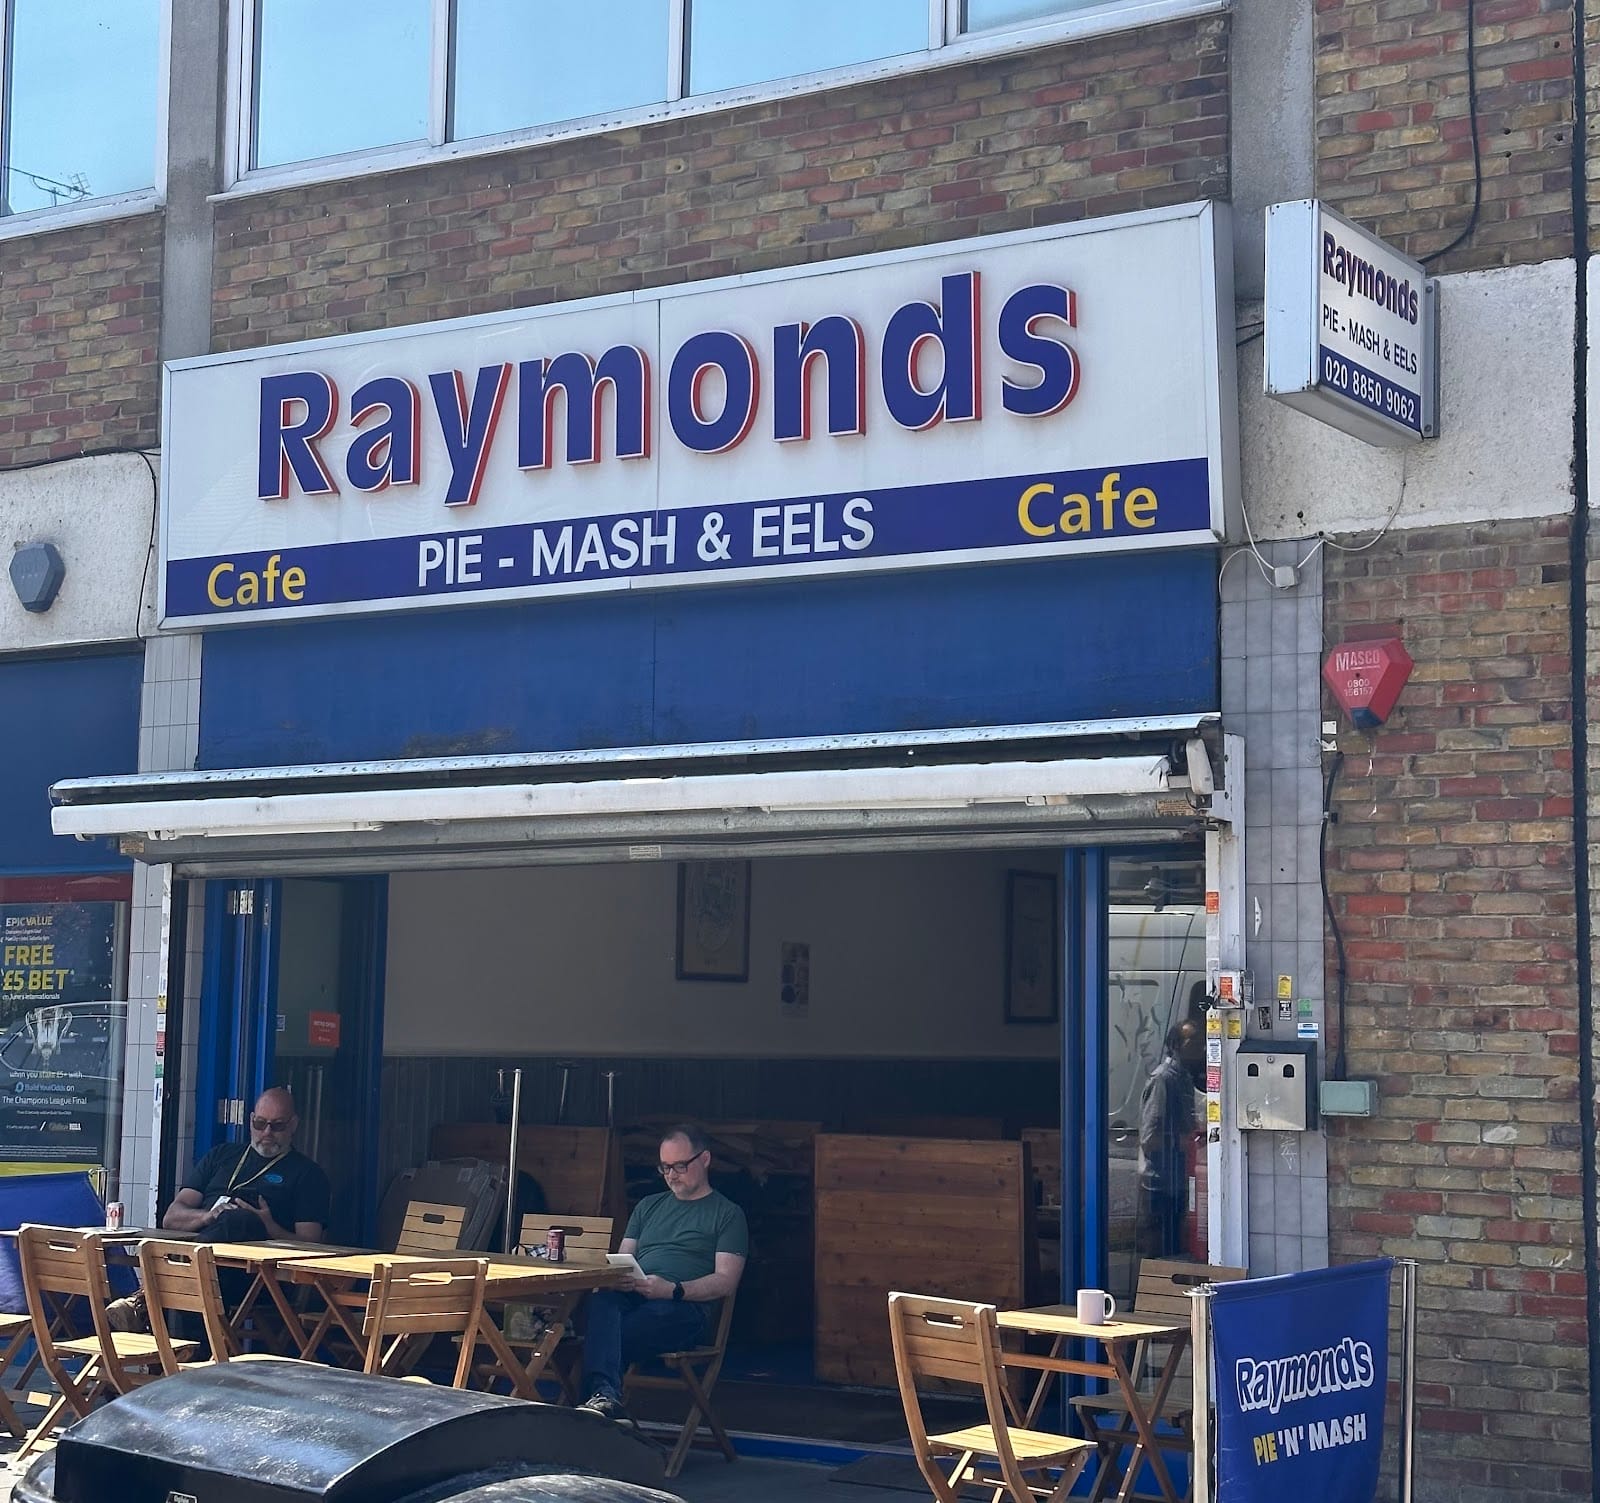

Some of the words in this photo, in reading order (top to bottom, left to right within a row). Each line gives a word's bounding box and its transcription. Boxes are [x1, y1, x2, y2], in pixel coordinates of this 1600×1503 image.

[1323, 231, 1418, 325] Raymonds
[1323, 303, 1338, 333] PIE
[1349, 318, 1380, 357] MASH
[1383, 339, 1391, 362] &
[1394, 344, 1417, 375] EELS
[258, 271, 1081, 507] Raymonds
[1325, 356, 1348, 389] 020
[1353, 373, 1382, 406] 8850
[1386, 388, 1415, 423] 9062
[1017, 472, 1158, 537] Cafe
[418, 535, 483, 587] PIE
[498, 557, 515, 568] -
[532, 515, 677, 577] MASH
[697, 511, 732, 562] &
[752, 497, 875, 558] EELS
[207, 555, 306, 607] Cafe
[1336, 650, 1380, 672] MASCO
[1347, 678, 1370, 688] 0800
[26, 916, 53, 926] VALUE
[3, 969, 24, 991] £5
[4, 944, 55, 966] FREE
[3, 1096, 14, 1104] The
[15, 1096, 48, 1105] Champions
[49, 1096, 72, 1106] League
[73, 1096, 87, 1105] Final
[26, 1071, 38, 1079] you
[1236, 1337, 1375, 1415] Raymonds
[1253, 1432, 1278, 1466] PIE
[1278, 1425, 1304, 1457] 'N'
[1309, 1413, 1367, 1451] MASH
